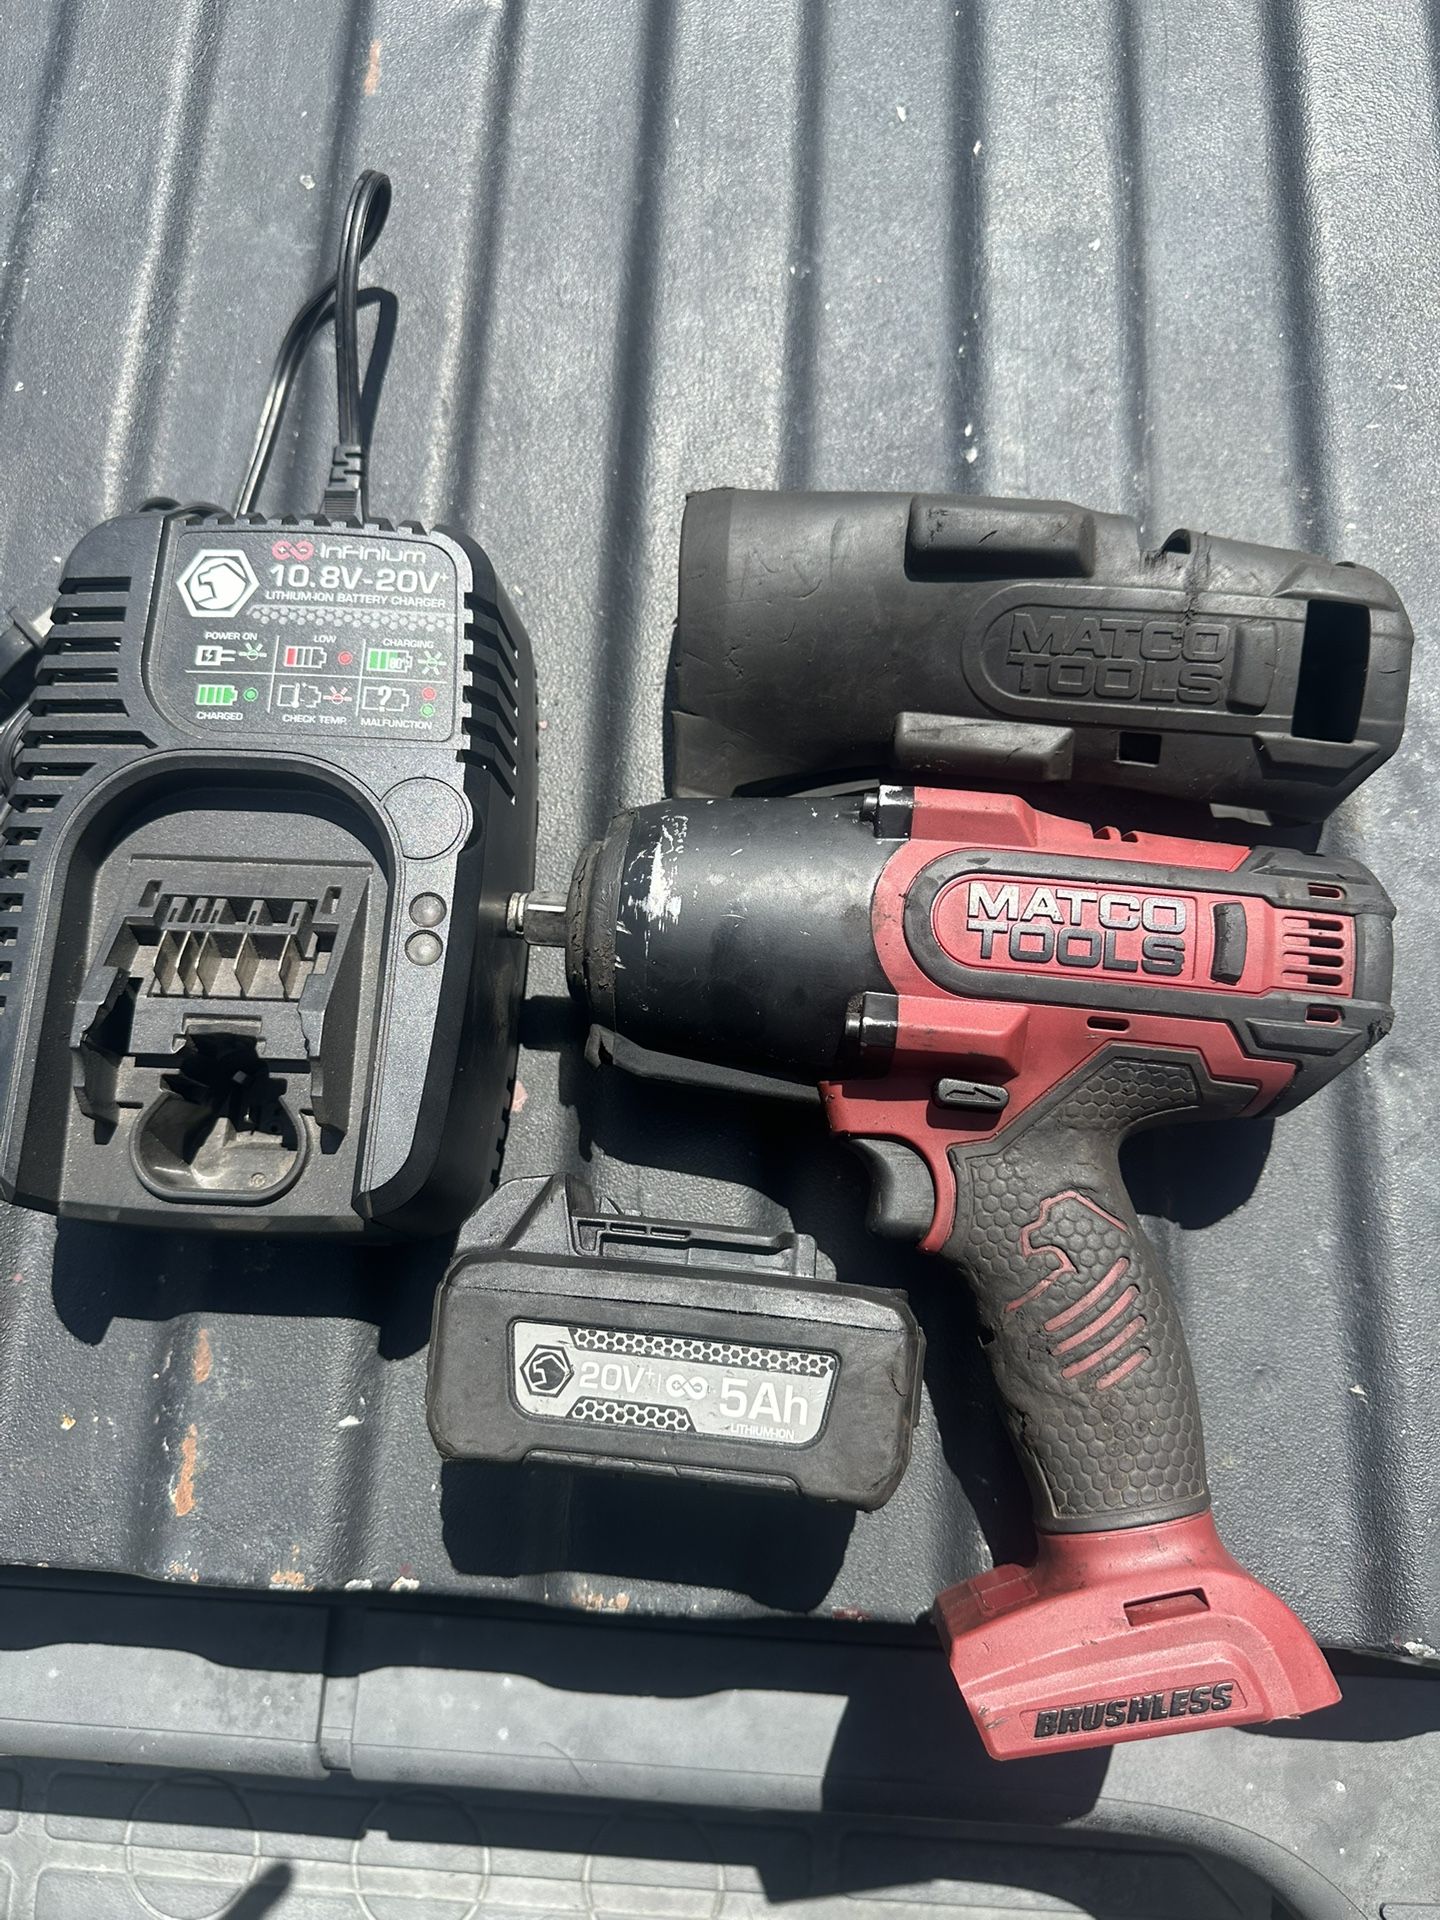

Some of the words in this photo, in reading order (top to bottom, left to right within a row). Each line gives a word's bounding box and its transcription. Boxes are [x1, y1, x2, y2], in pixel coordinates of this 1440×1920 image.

[265, 590, 334, 602] LITHIUM-ION
[337, 593, 388, 605] BATTERY
[390, 597, 446, 609] CHARGER
[204, 631, 240, 640] POWER
[242, 632, 258, 641] ON
[313, 634, 337, 644] LOW
[382, 638, 435, 650] CHARGING
[1008, 612, 1230, 663] MATCO
[1006, 652, 1223, 704] TOOLS
[196, 711, 244, 721] CHARGED
[282, 714, 318, 723] CHECK
[360, 717, 433, 730] MALFUNCTION
[967, 882, 1187, 934] MATCO
[966, 919, 1186, 976] TOOLS
[719, 1375, 809, 1427] 5Ah
[730, 1423, 796, 1441] LITHIUM-ION
[1034, 1682, 1233, 1737] BRUSHLESS
